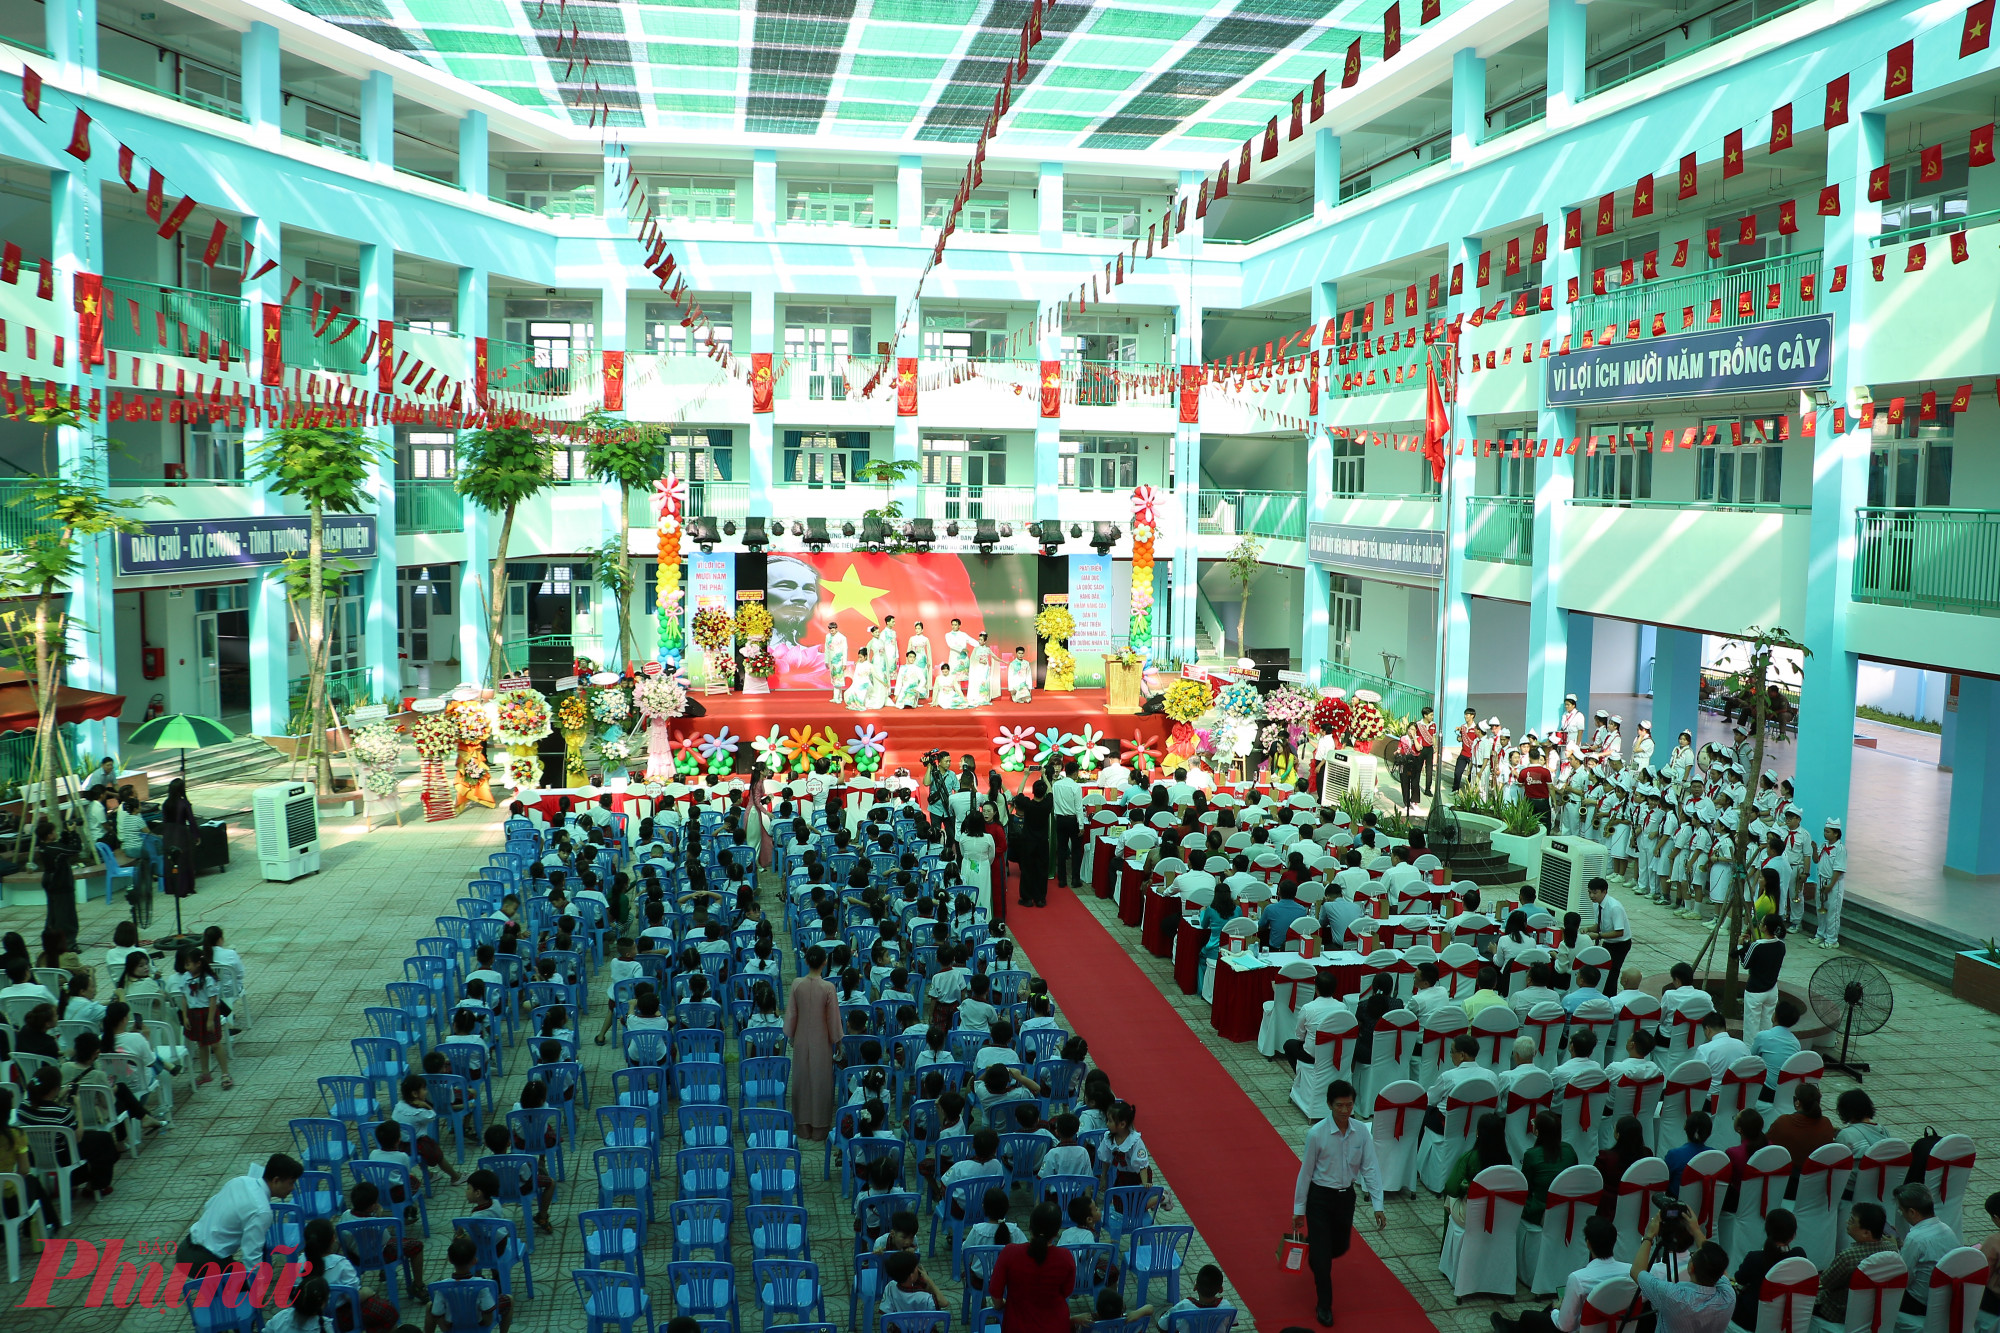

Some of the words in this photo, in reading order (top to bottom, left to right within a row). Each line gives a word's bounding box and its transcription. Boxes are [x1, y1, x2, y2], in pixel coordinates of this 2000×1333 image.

[1553, 362, 1566, 391] VÌ
[1570, 362, 1591, 396] LỢI
[1595, 358, 1619, 388] ÍCH
[1623, 350, 1662, 386] MƯỜI
[1667, 348, 1703, 381] NĂM
[1709, 336, 1772, 377] TRỒNG
[1777, 333, 1821, 371] CÂY
[158, 526, 181, 561] CHỦ
[190, 525, 204, 559] KỶ
[248, 526, 271, 554] TÌNH
[272, 527, 308, 553] THƯƠNG
[343, 522, 370, 553] NHIỆM
